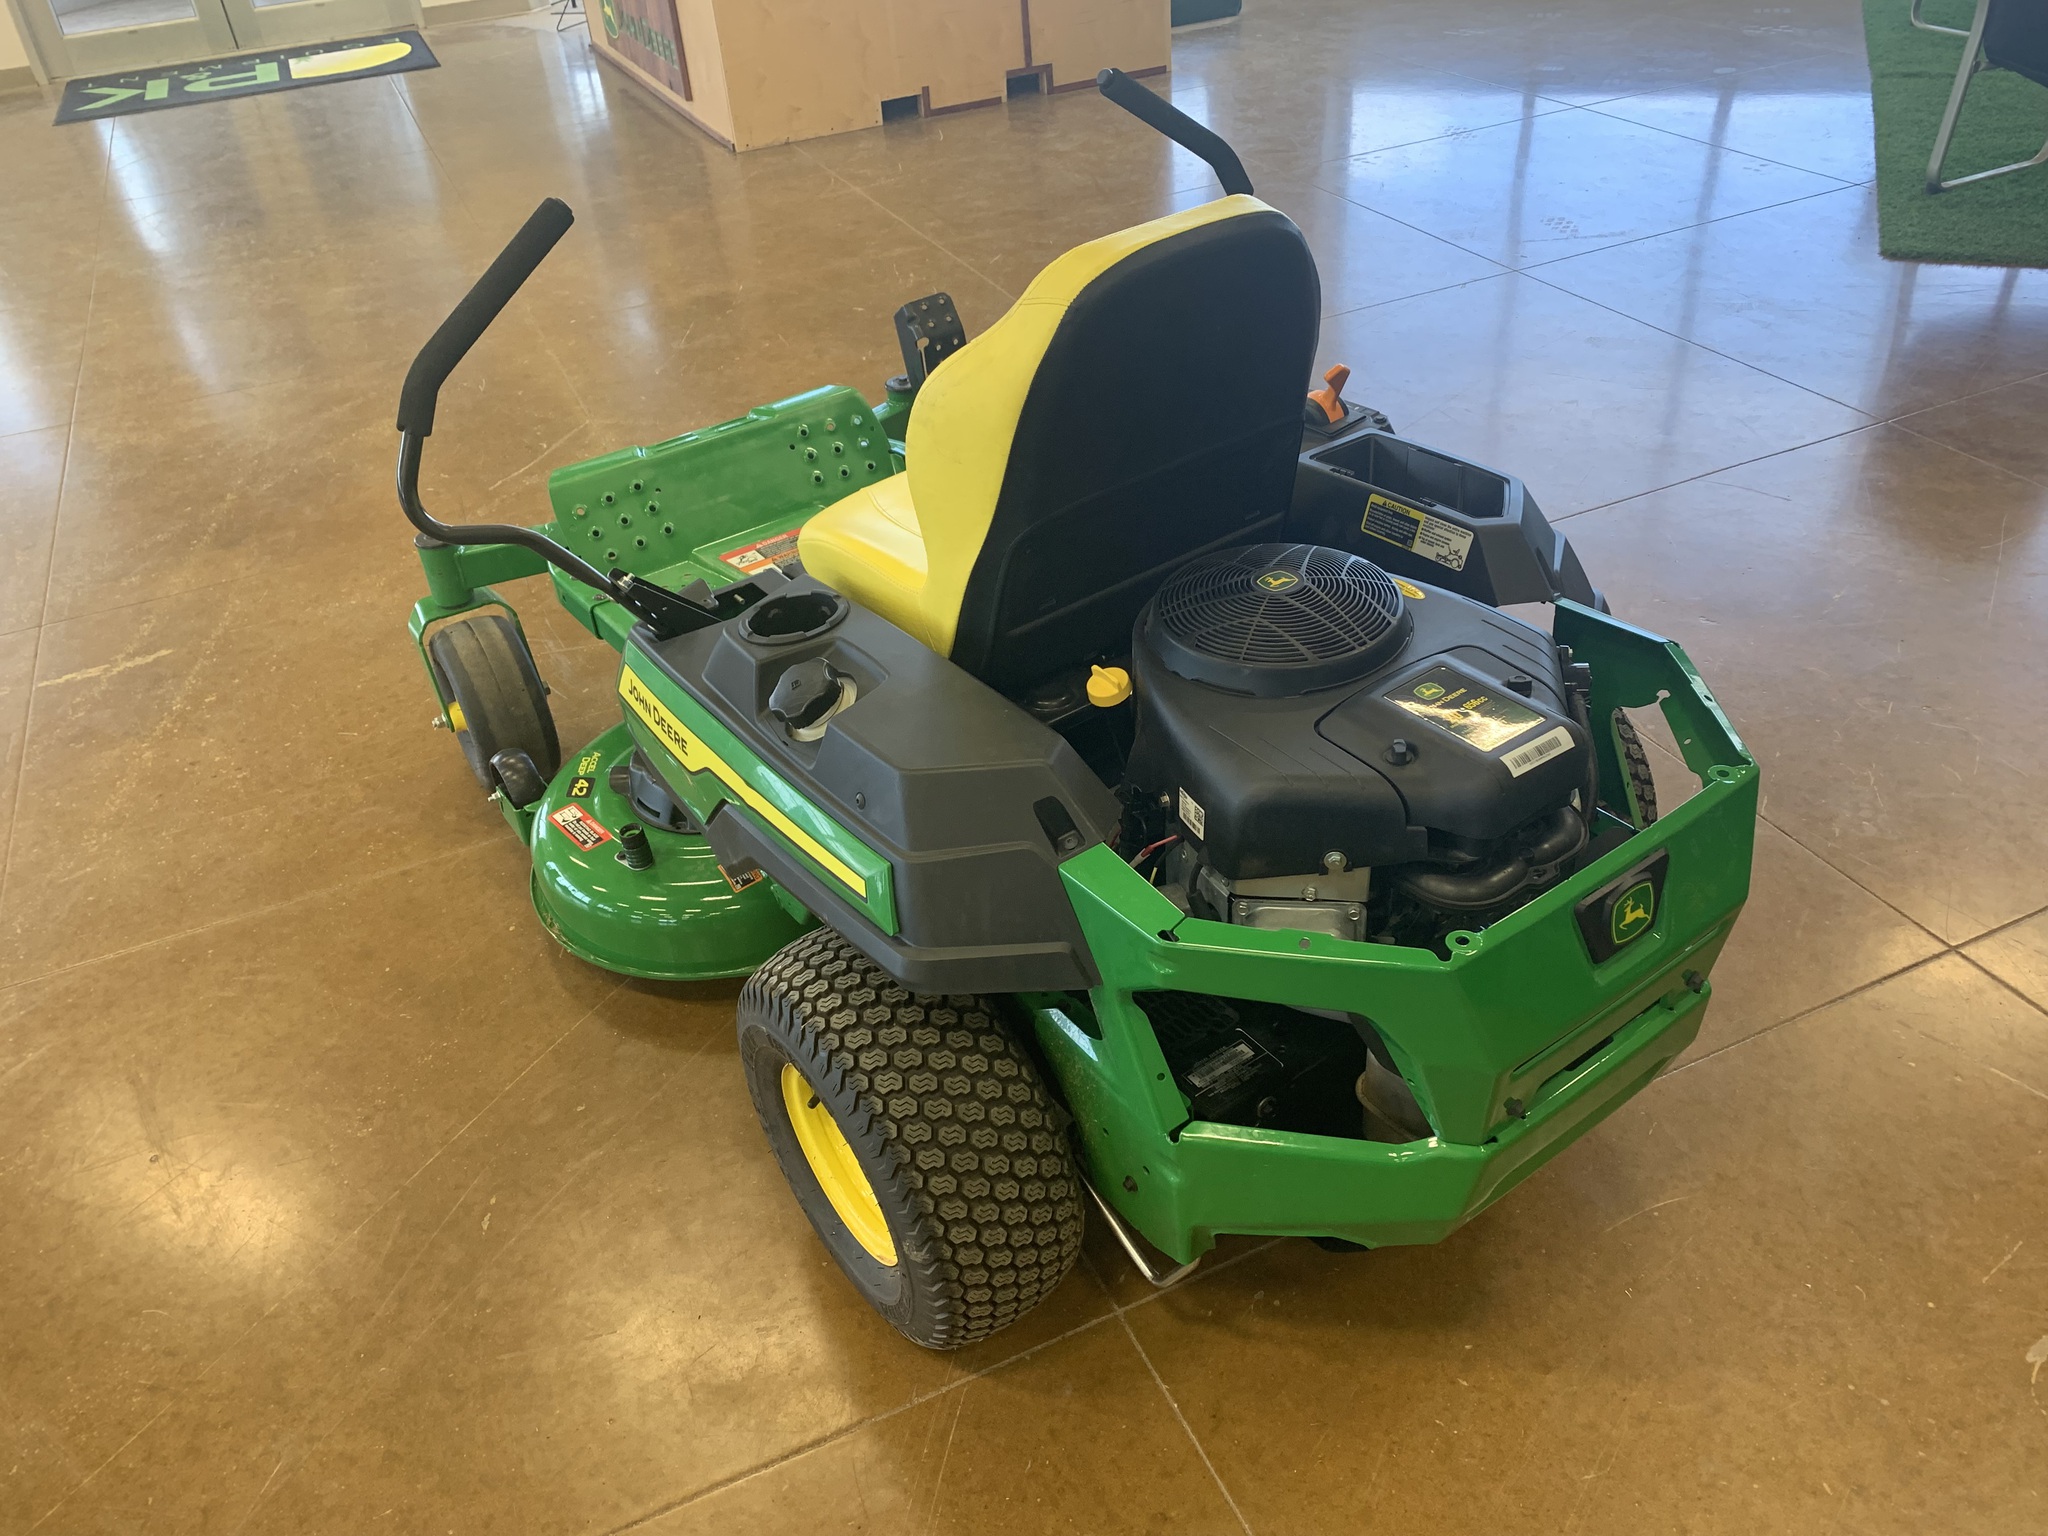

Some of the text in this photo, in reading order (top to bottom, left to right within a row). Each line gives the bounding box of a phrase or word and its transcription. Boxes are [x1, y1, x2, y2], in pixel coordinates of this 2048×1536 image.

[1388, 502, 1411, 516] CAUTION
[627, 679, 690, 757] JOHN DEERE
[576, 756, 589, 777] DEEP
[586, 751, 602, 774] ACCEL
[571, 779, 589, 798] 42
